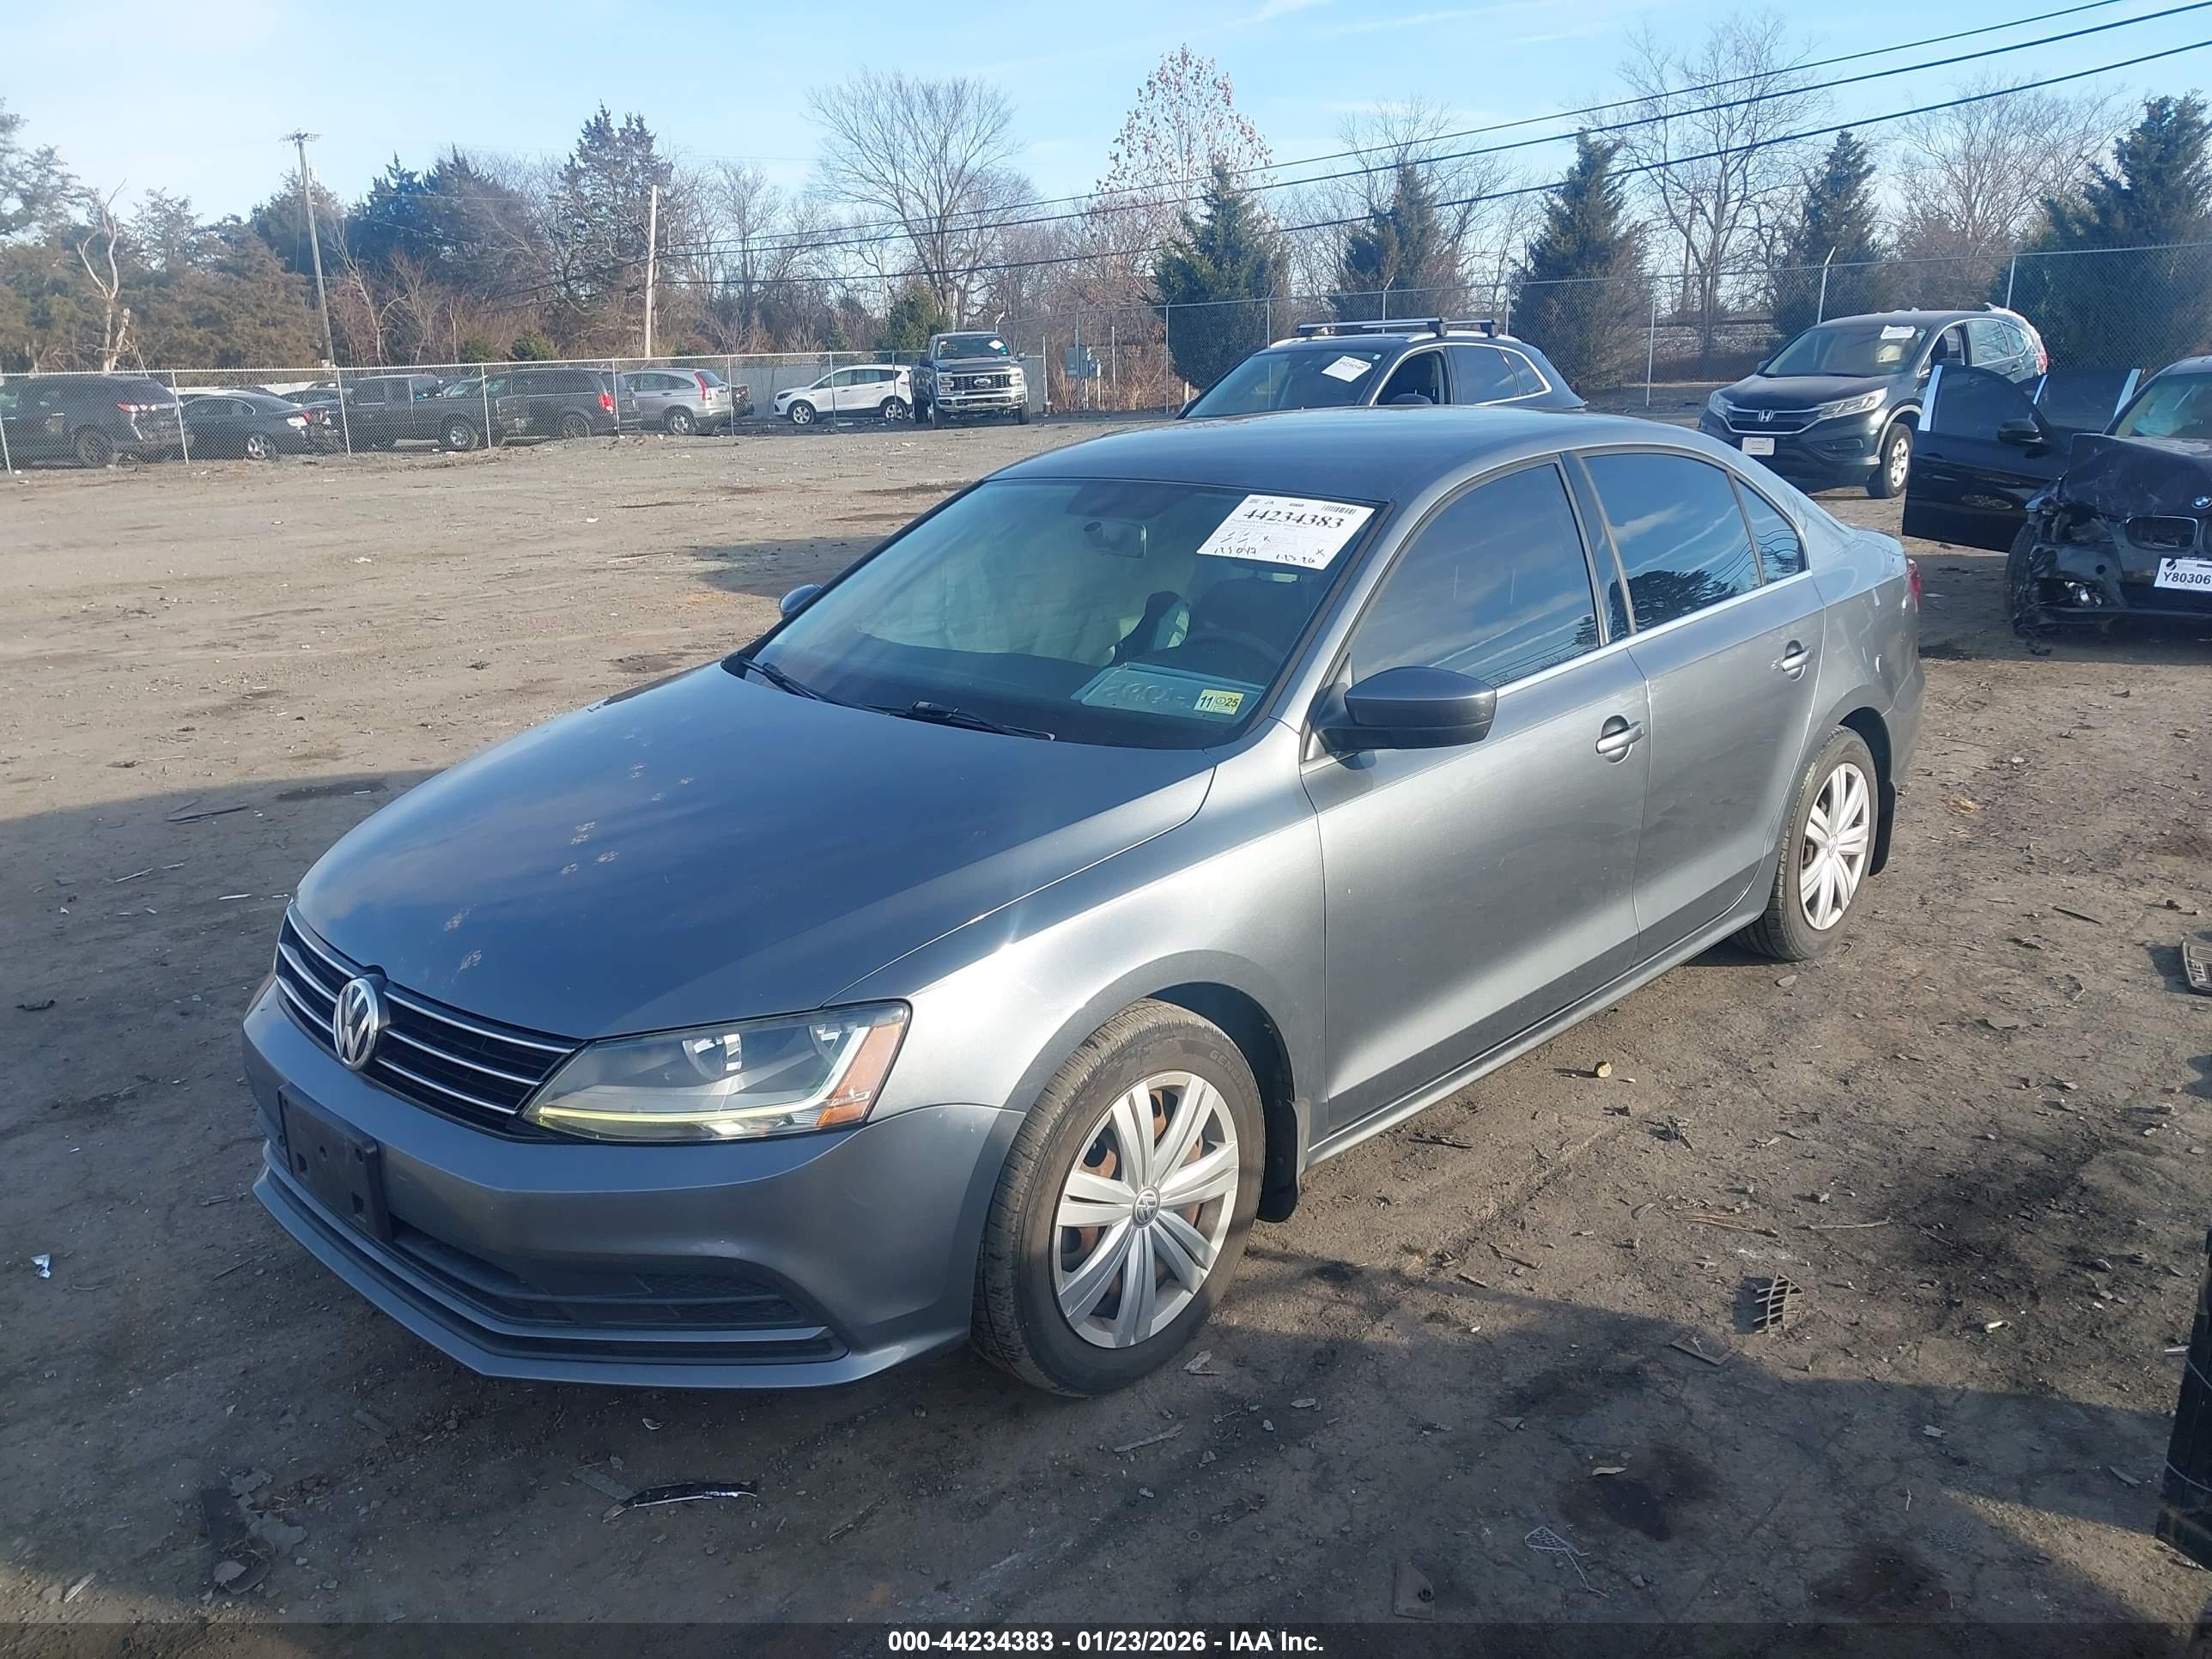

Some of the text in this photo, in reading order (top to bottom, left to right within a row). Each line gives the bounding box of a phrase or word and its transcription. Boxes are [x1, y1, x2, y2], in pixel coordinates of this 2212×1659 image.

[1243, 509, 1344, 528] 44234383
[2164, 572, 2211, 585] Y80306
[1200, 695, 1239, 708] 11 25
